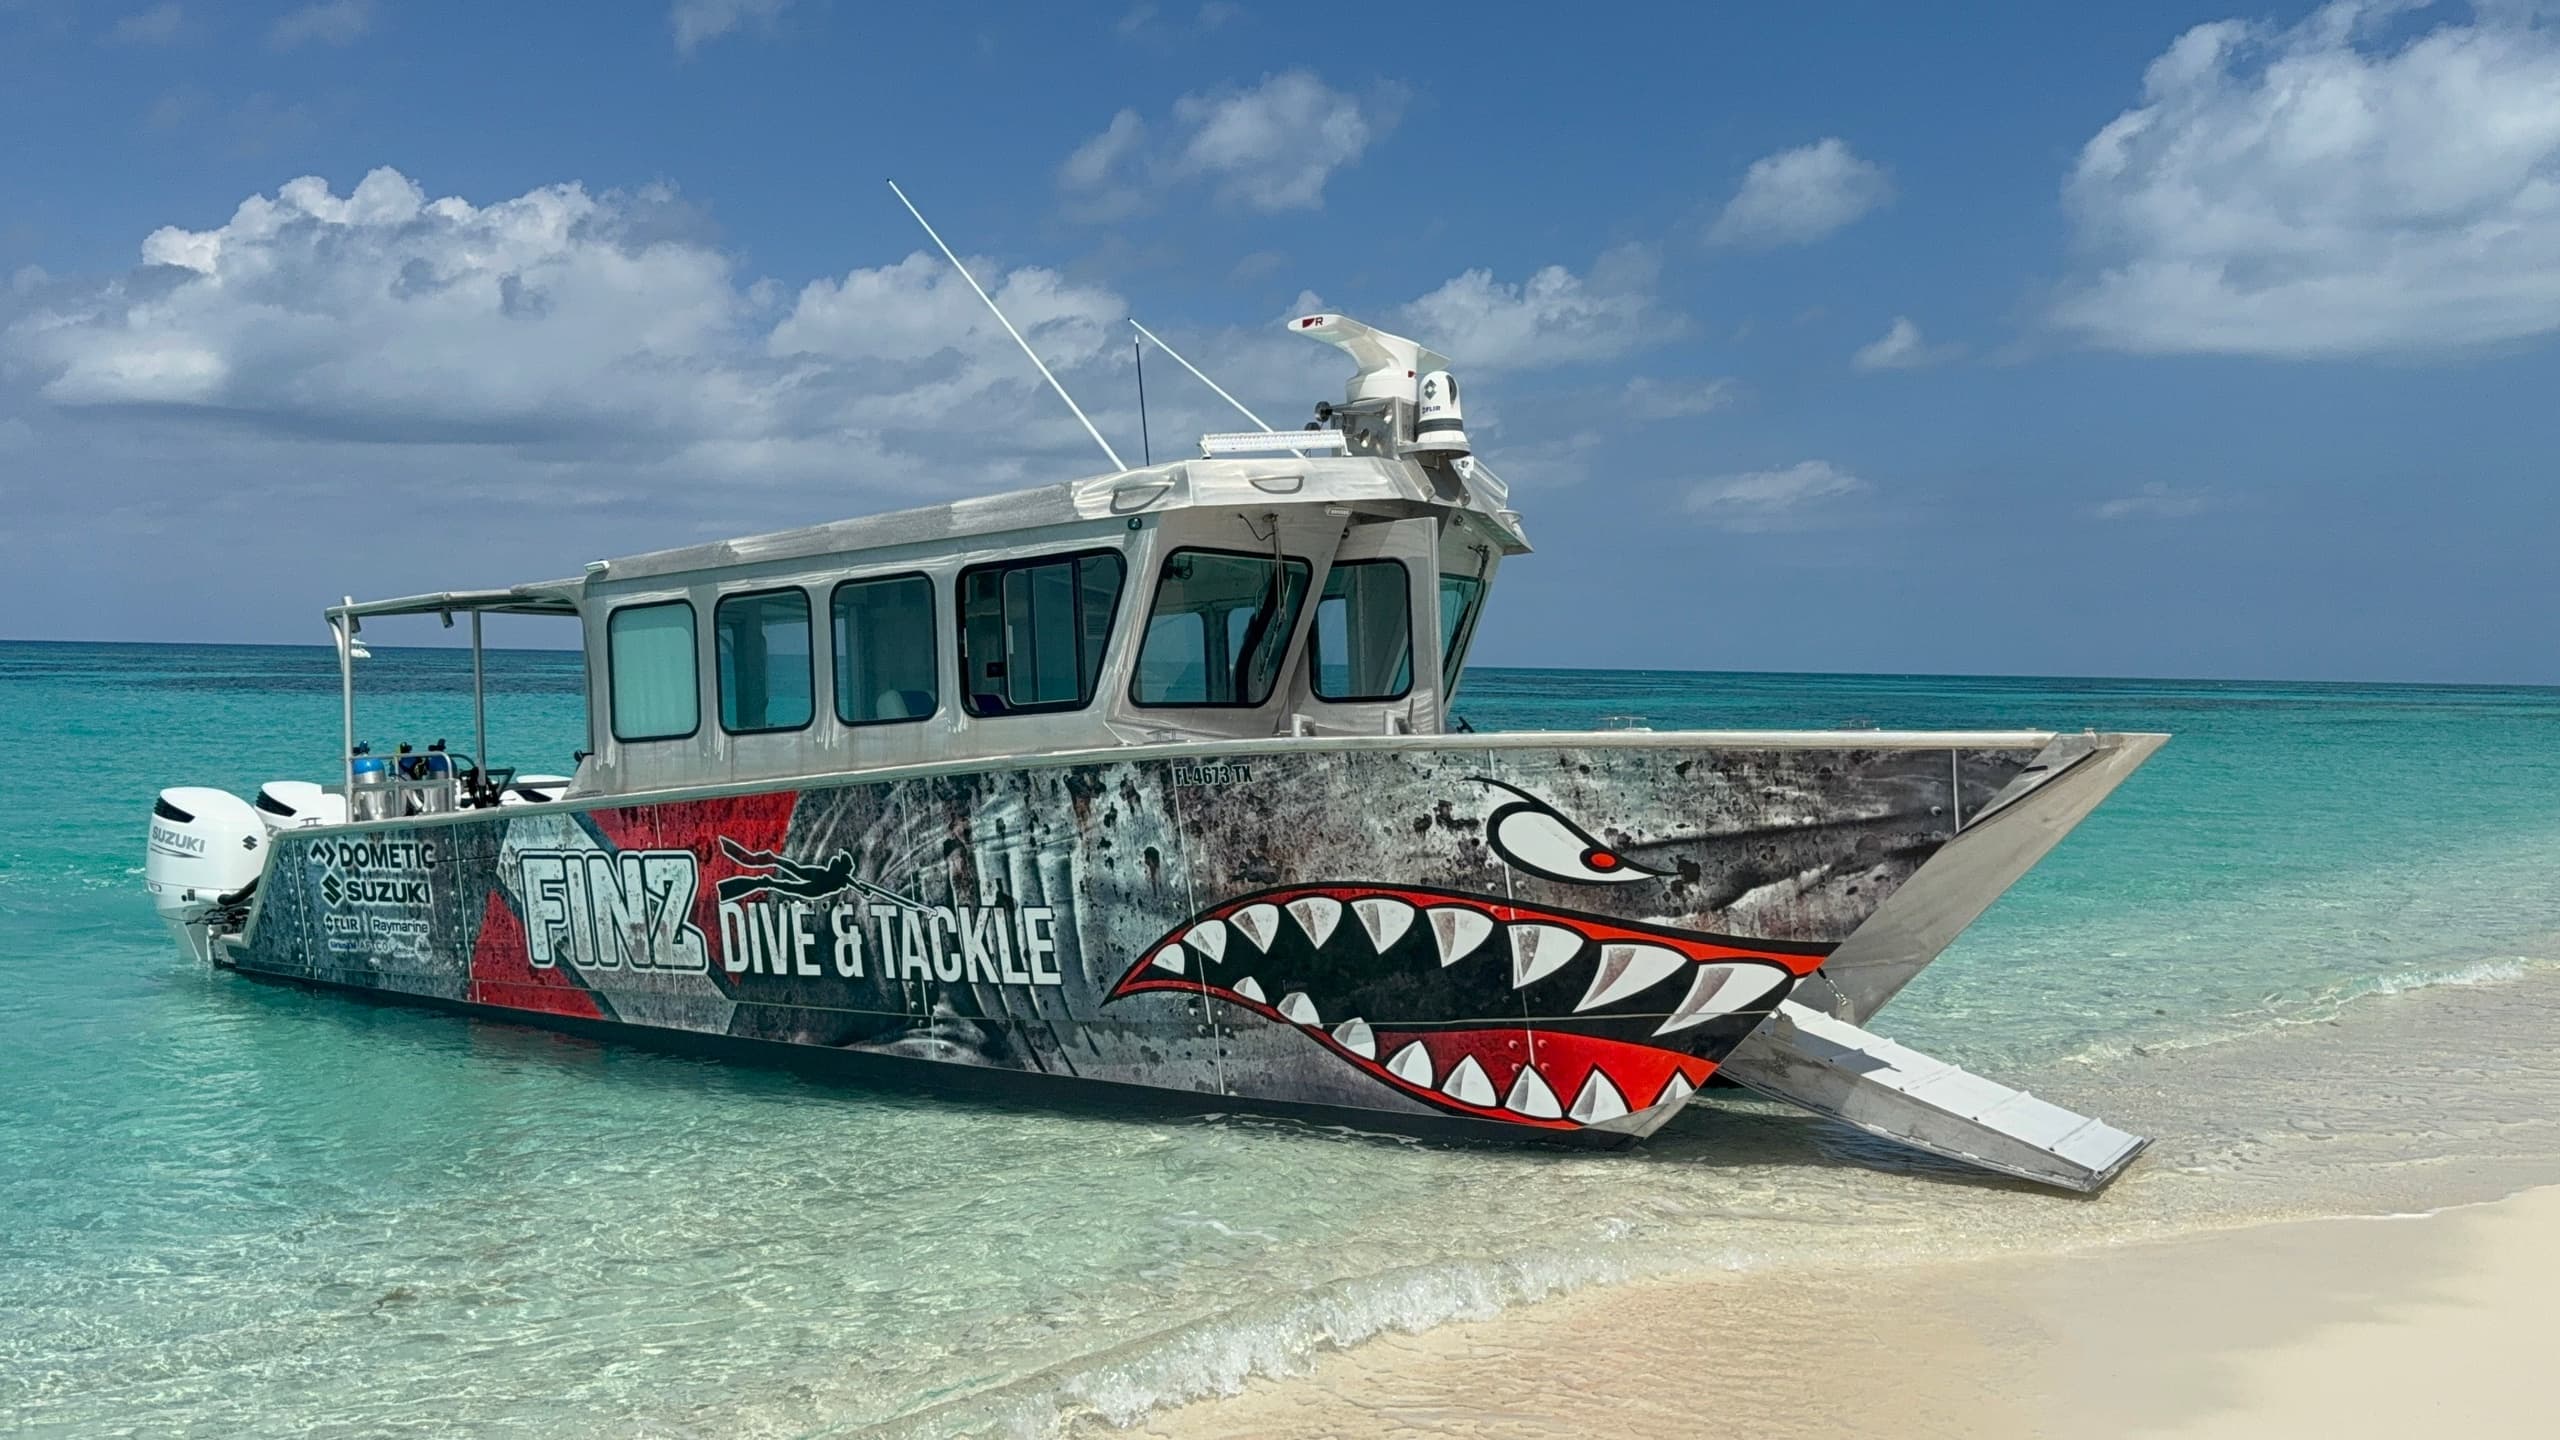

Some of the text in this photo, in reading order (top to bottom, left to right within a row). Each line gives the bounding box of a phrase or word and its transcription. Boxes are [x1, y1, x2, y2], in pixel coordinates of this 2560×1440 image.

[1194, 766, 1230, 784] 4673
[1233, 765, 1253, 782] TX
[152, 826, 205, 852] SUZUKI
[339, 842, 436, 870] DOMETIC
[346, 881, 431, 904] SUZUKI
[334, 917, 429, 934] FLIR Raymarine
[519, 851, 708, 975] FINZ
[720, 902, 1062, 985] DIVE & TACKLE
